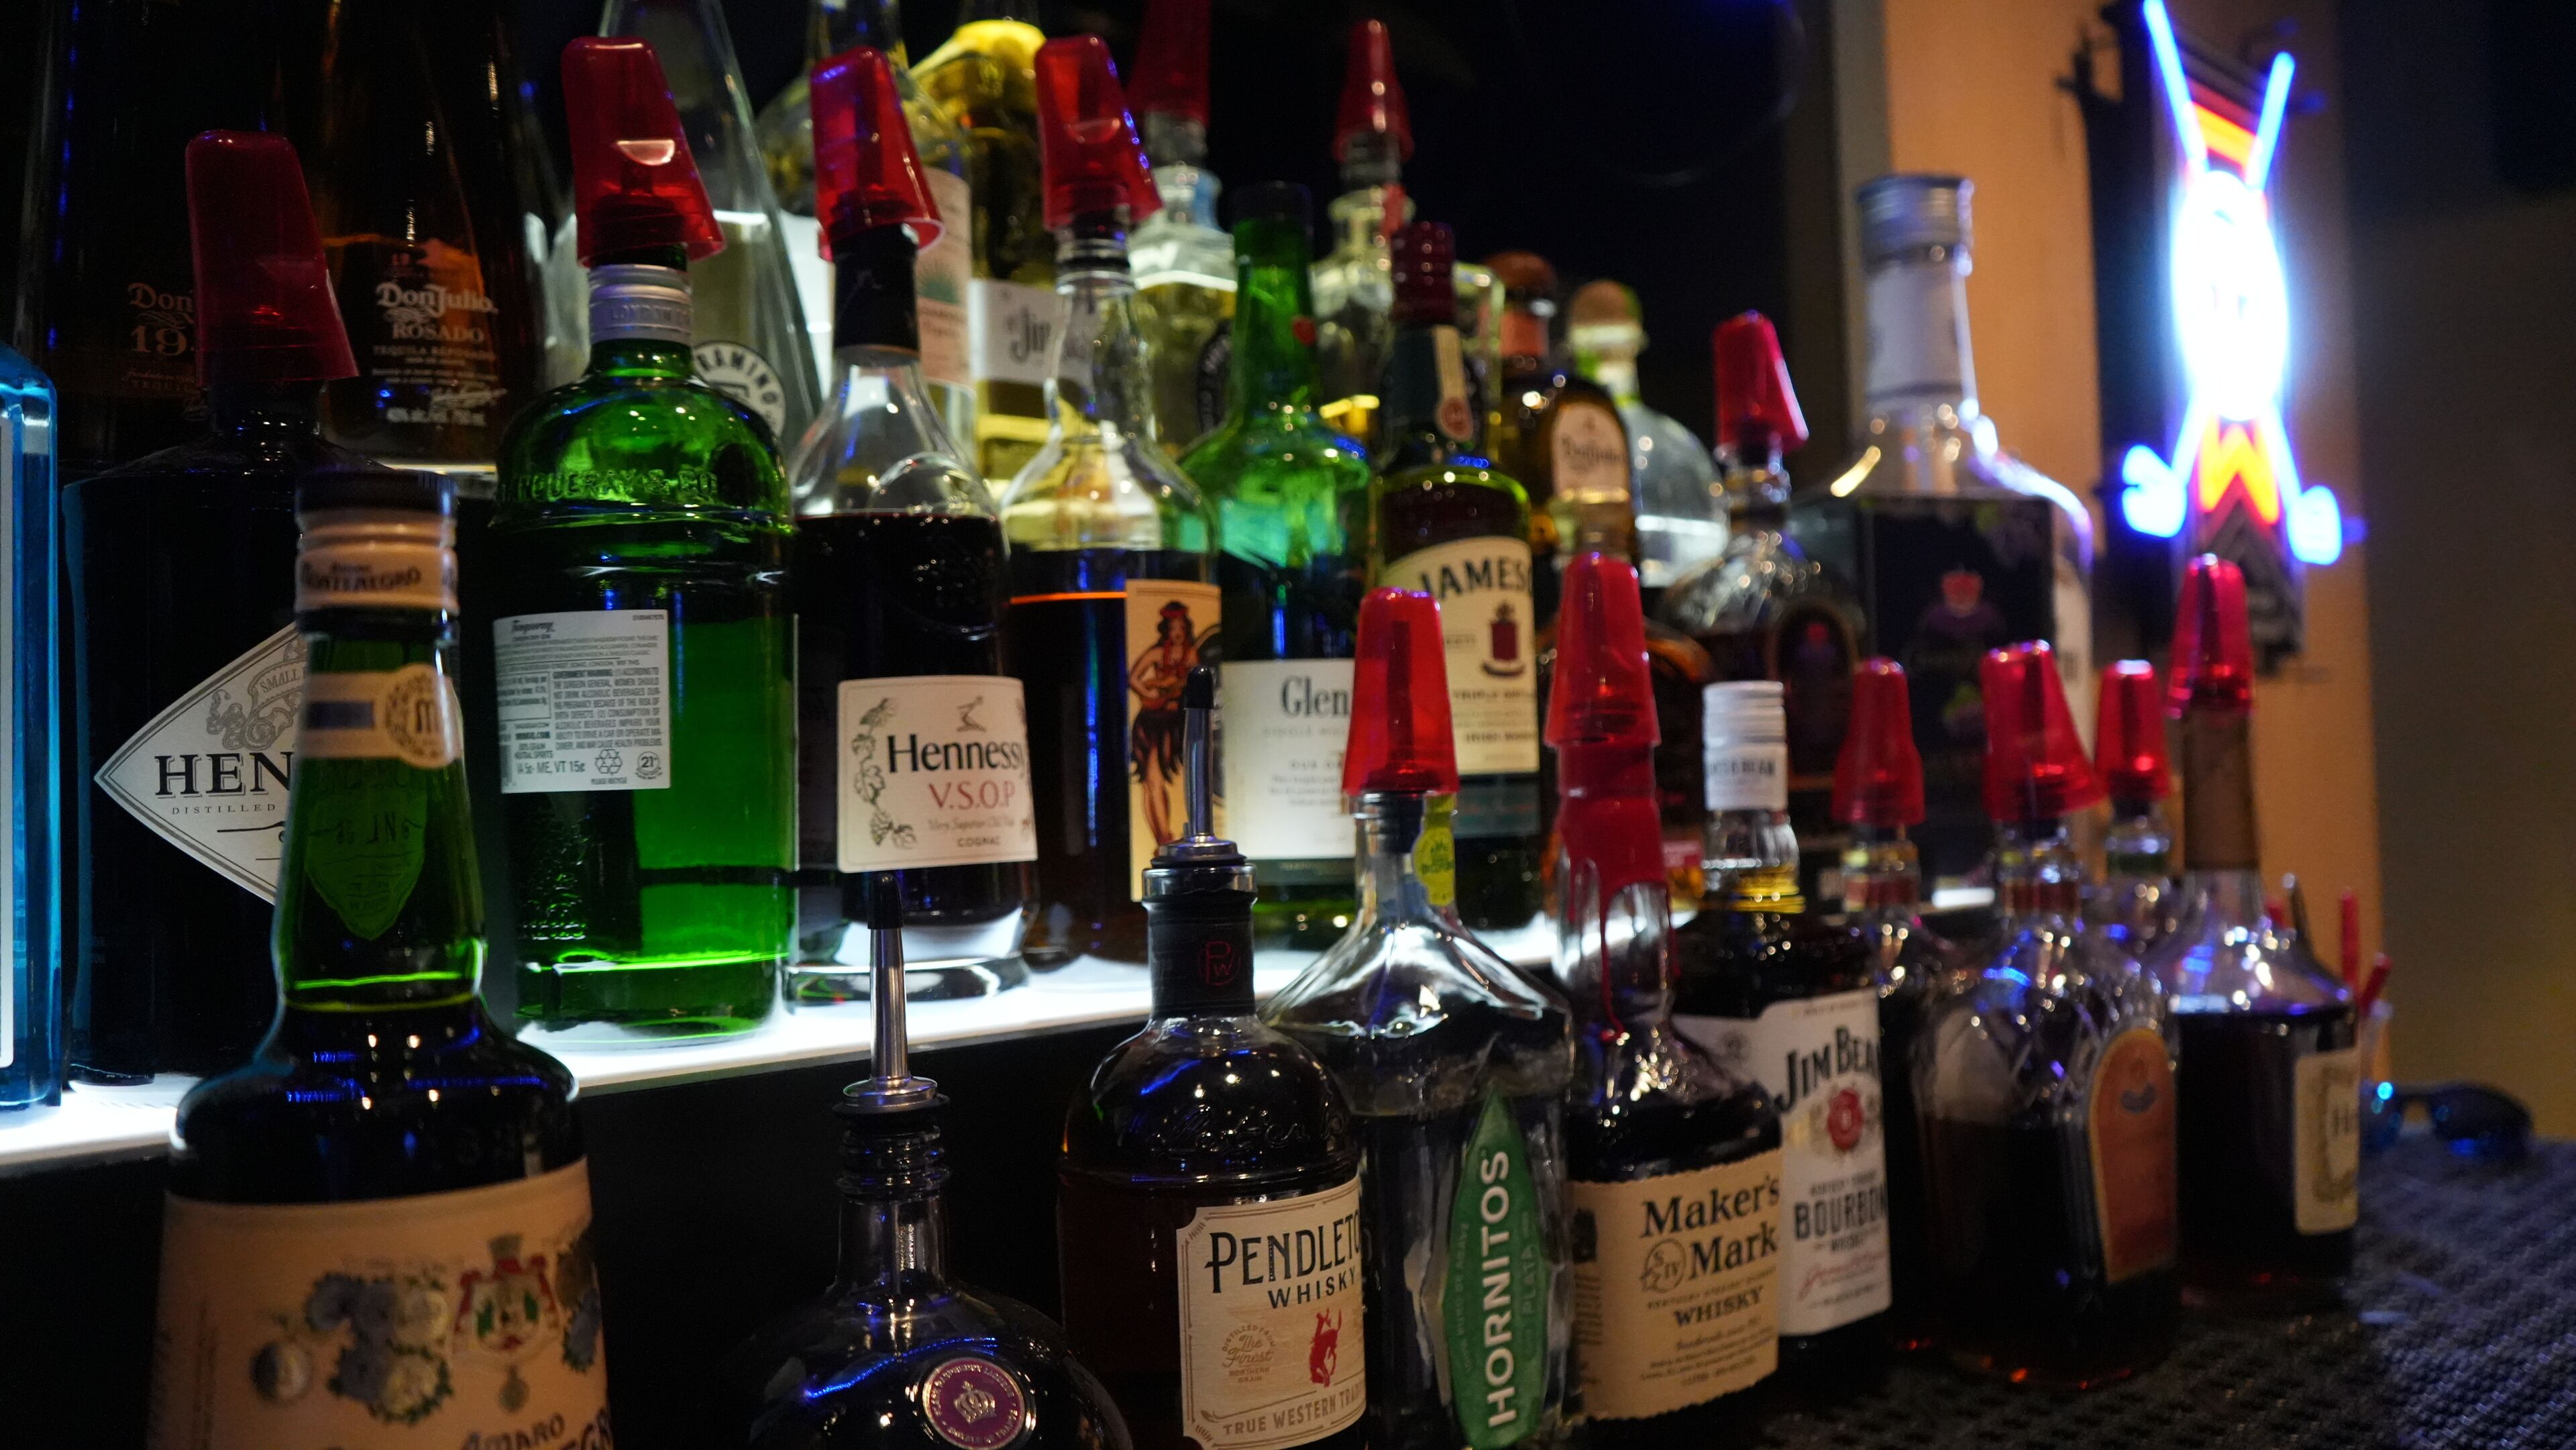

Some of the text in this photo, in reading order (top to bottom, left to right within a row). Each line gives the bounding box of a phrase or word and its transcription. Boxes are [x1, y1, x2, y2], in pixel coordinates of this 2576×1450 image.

[131, 325, 195, 357] 19
[1419, 556, 1533, 599] JAMES
[260, 668, 301, 693] SMALL
[554, 761, 567, 773] VT
[172, 804, 276, 815] DISTILLED
[1774, 1042, 1832, 1112] JIM
[1640, 1174, 1781, 1239] Maker's
[1687, 1220, 1778, 1281] Mark
[1267, 1265, 1356, 1309] WHISKY
[1480, 1150, 1517, 1428] HORNITOS
[1519, 1244, 1536, 1315] PLATA
[1674, 1284, 1766, 1327] WHISKY
[1222, 1324, 1258, 1352] DISTILLED
[1238, 1335, 1263, 1352] The
[1222, 1347, 1275, 1368] Finest
[1229, 1367, 1271, 1377] NORTHERN
[1238, 1376, 1263, 1384] GRAIN
[1223, 1416, 1267, 1435] TRUE
[1273, 1394, 1337, 1429] WESTERN
